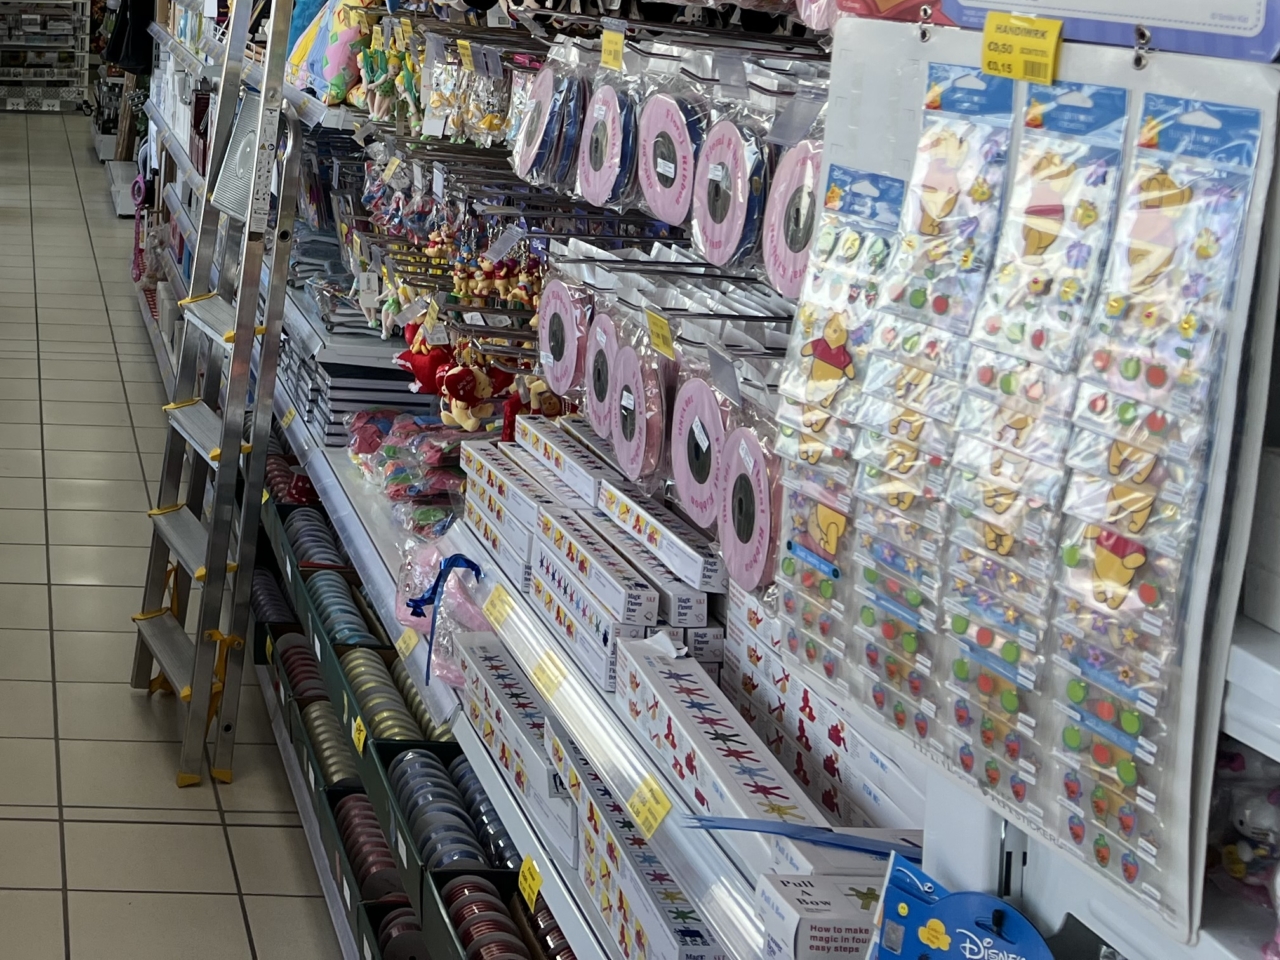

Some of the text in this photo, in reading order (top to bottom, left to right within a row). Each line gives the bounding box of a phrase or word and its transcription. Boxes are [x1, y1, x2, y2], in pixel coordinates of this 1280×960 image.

[780, 880, 815, 888] Pull
[796, 898, 831, 906] Bow
[844, 926, 869, 934] make
[809, 935, 839, 944] magic
[841, 935, 850, 943] in
[809, 945, 859, 954] easy steps
